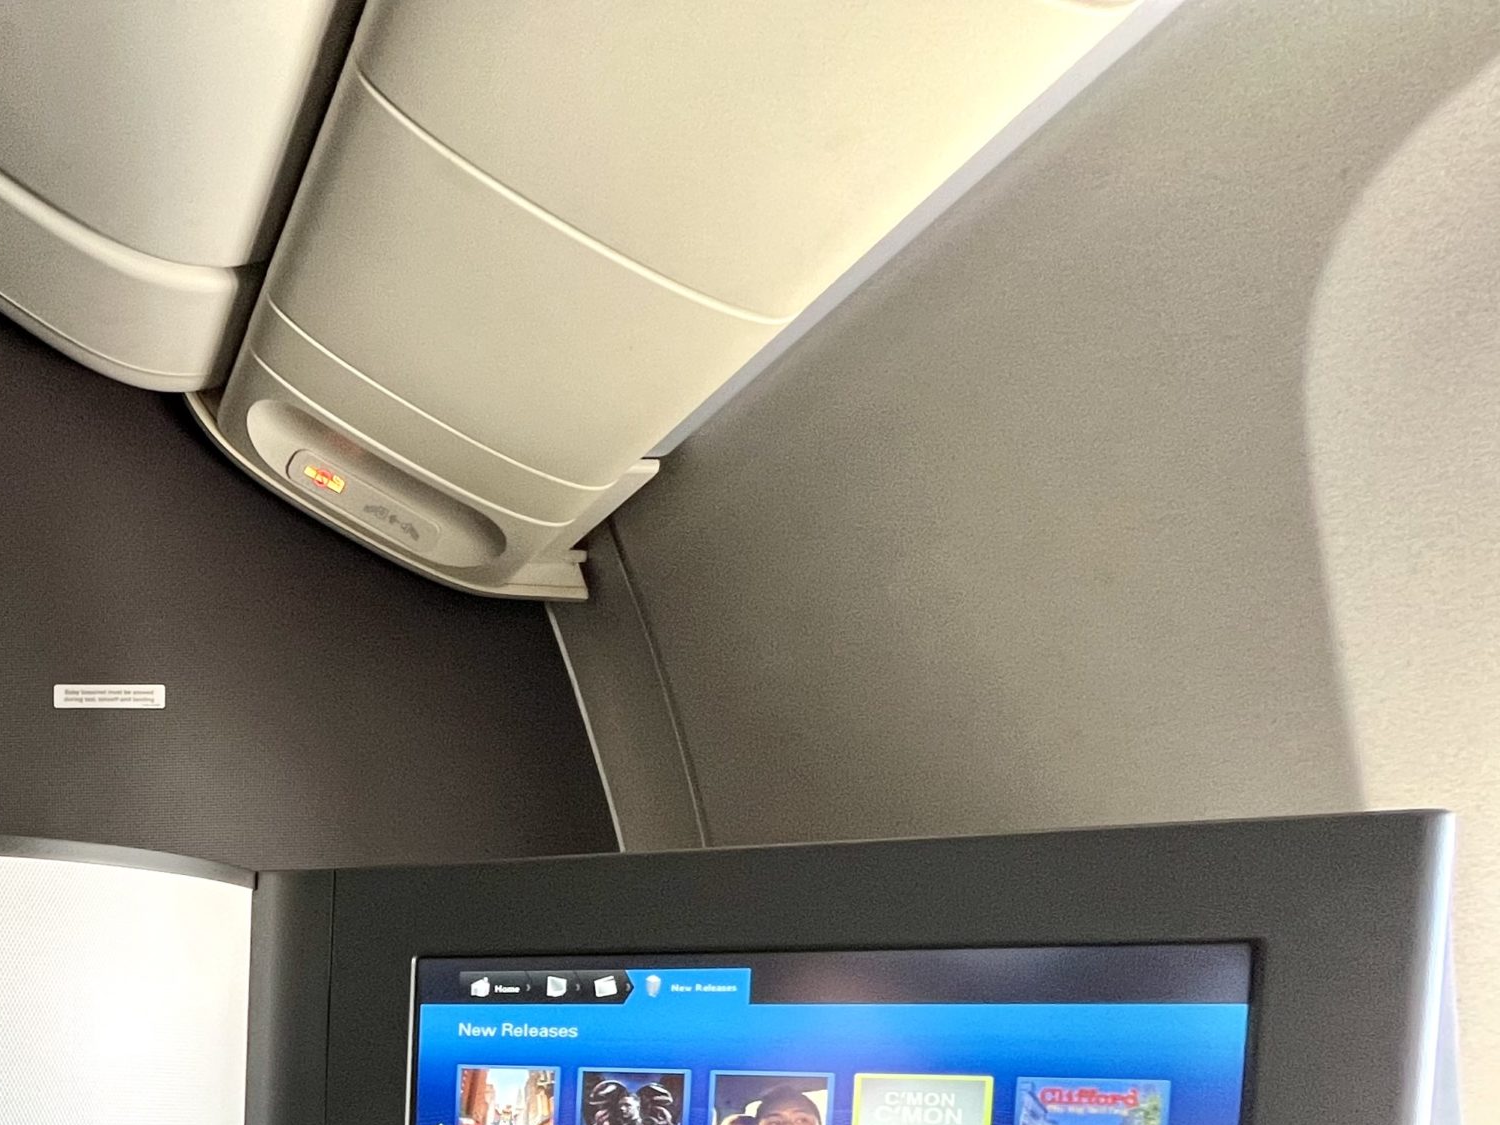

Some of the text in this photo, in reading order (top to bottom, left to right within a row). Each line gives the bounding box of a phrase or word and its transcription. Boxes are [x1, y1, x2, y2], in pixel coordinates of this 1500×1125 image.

[494, 984, 520, 994] Home
[670, 983, 737, 992] New Releases
[458, 1023, 579, 1038] New Releases
[1039, 1087, 1140, 1109] Clifford
